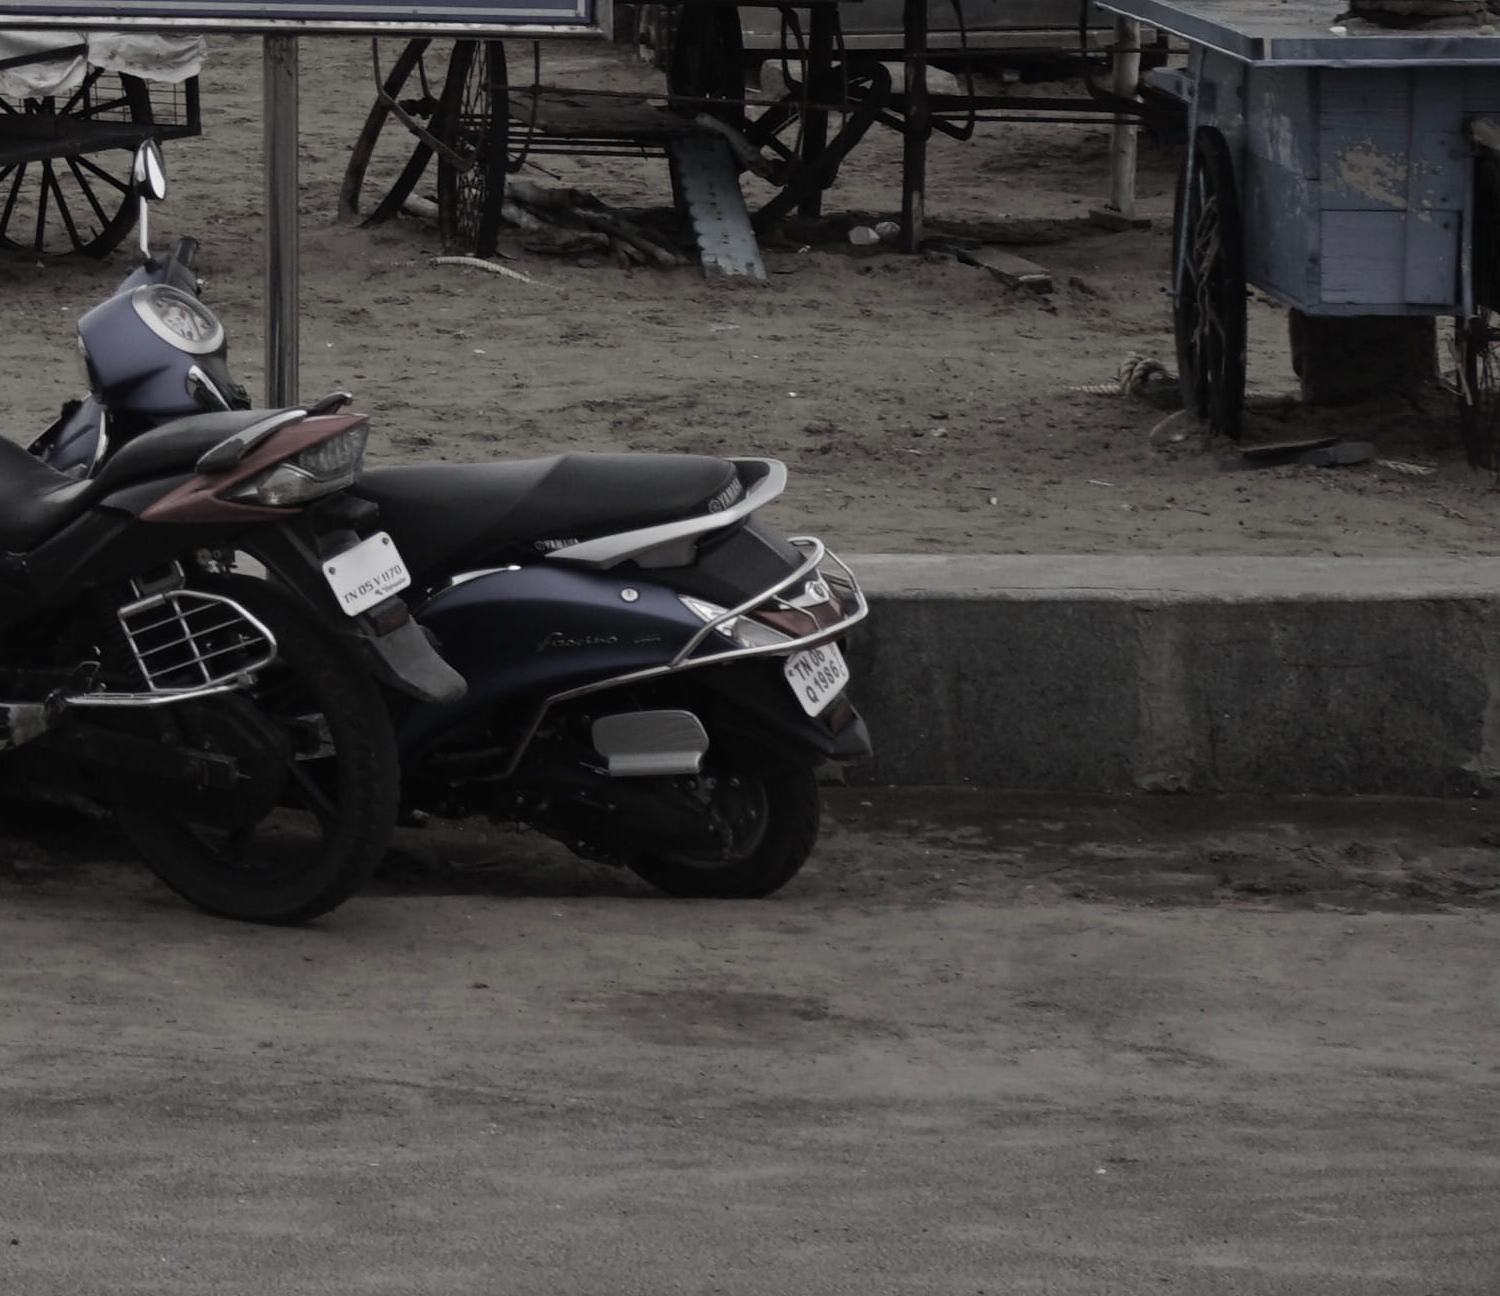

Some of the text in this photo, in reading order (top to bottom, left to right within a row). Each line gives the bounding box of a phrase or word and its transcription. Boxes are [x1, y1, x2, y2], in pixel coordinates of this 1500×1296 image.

[343, 590, 358, 604] TN
[358, 581, 374, 595] 05
[794, 648, 825, 682] TN 06
[814, 660, 839, 693] 1986
